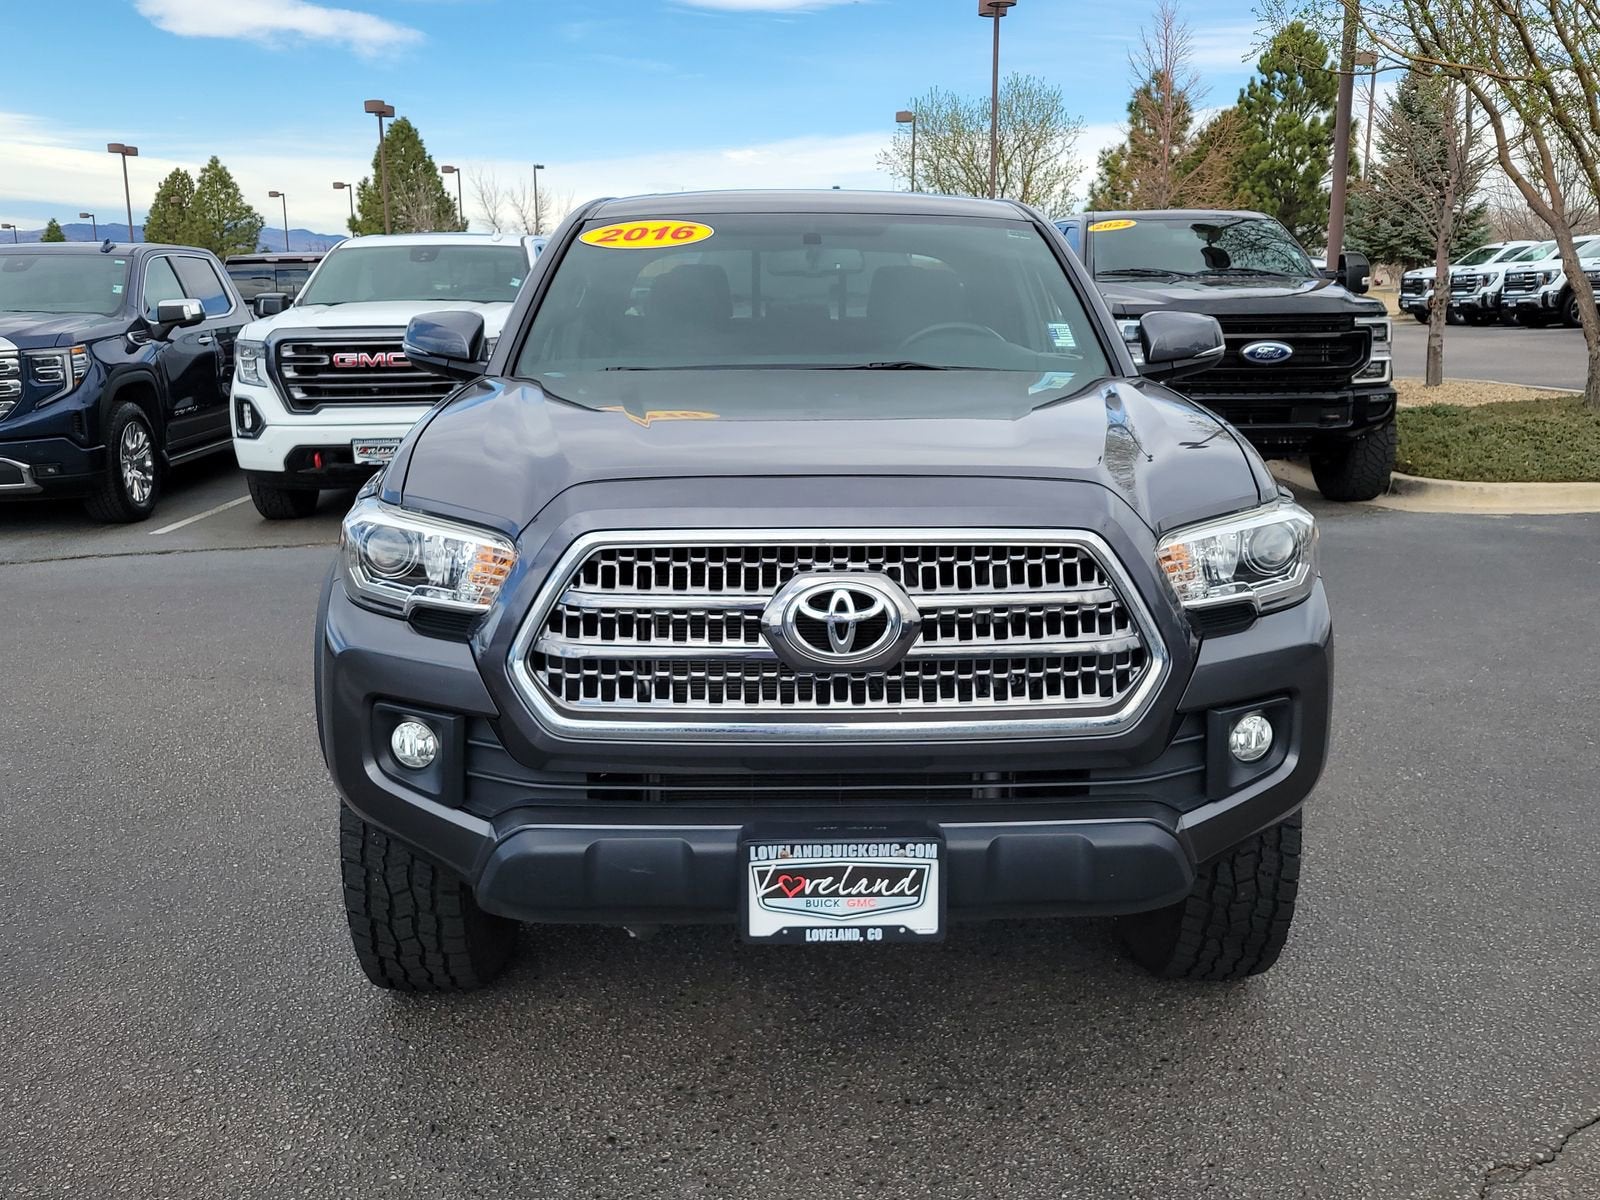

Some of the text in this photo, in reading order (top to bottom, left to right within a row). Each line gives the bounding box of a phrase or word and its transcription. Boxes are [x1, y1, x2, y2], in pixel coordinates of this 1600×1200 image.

[595, 226, 697, 243] 2016
[1255, 346, 1282, 359] Ford
[333, 352, 412, 368] GMC
[805, 898, 877, 908] BUICK GMC
[805, 928, 883, 942] LOVELAND, CO
